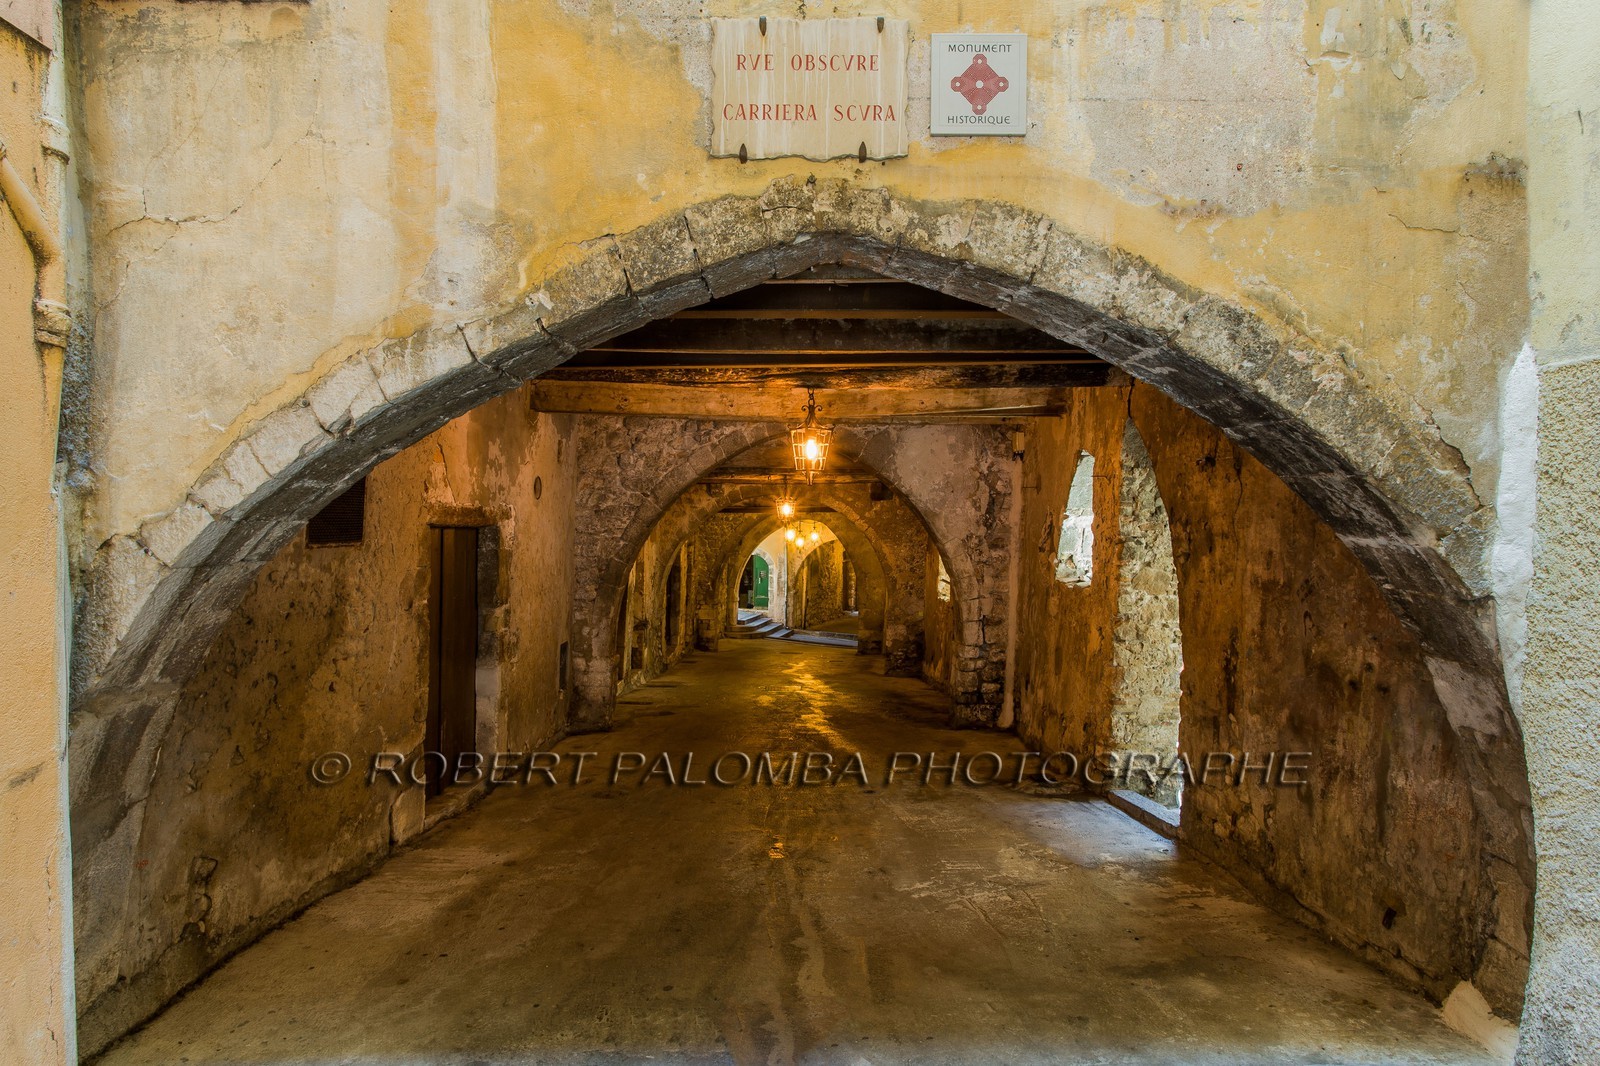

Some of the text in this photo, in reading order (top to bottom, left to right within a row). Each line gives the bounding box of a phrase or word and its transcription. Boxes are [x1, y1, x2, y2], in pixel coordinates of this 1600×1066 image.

[947, 43, 1012, 53] MONUMENT
[723, 103, 897, 122] CARRIERA SCVRA
[947, 115, 1011, 125] HISTORIQUE
